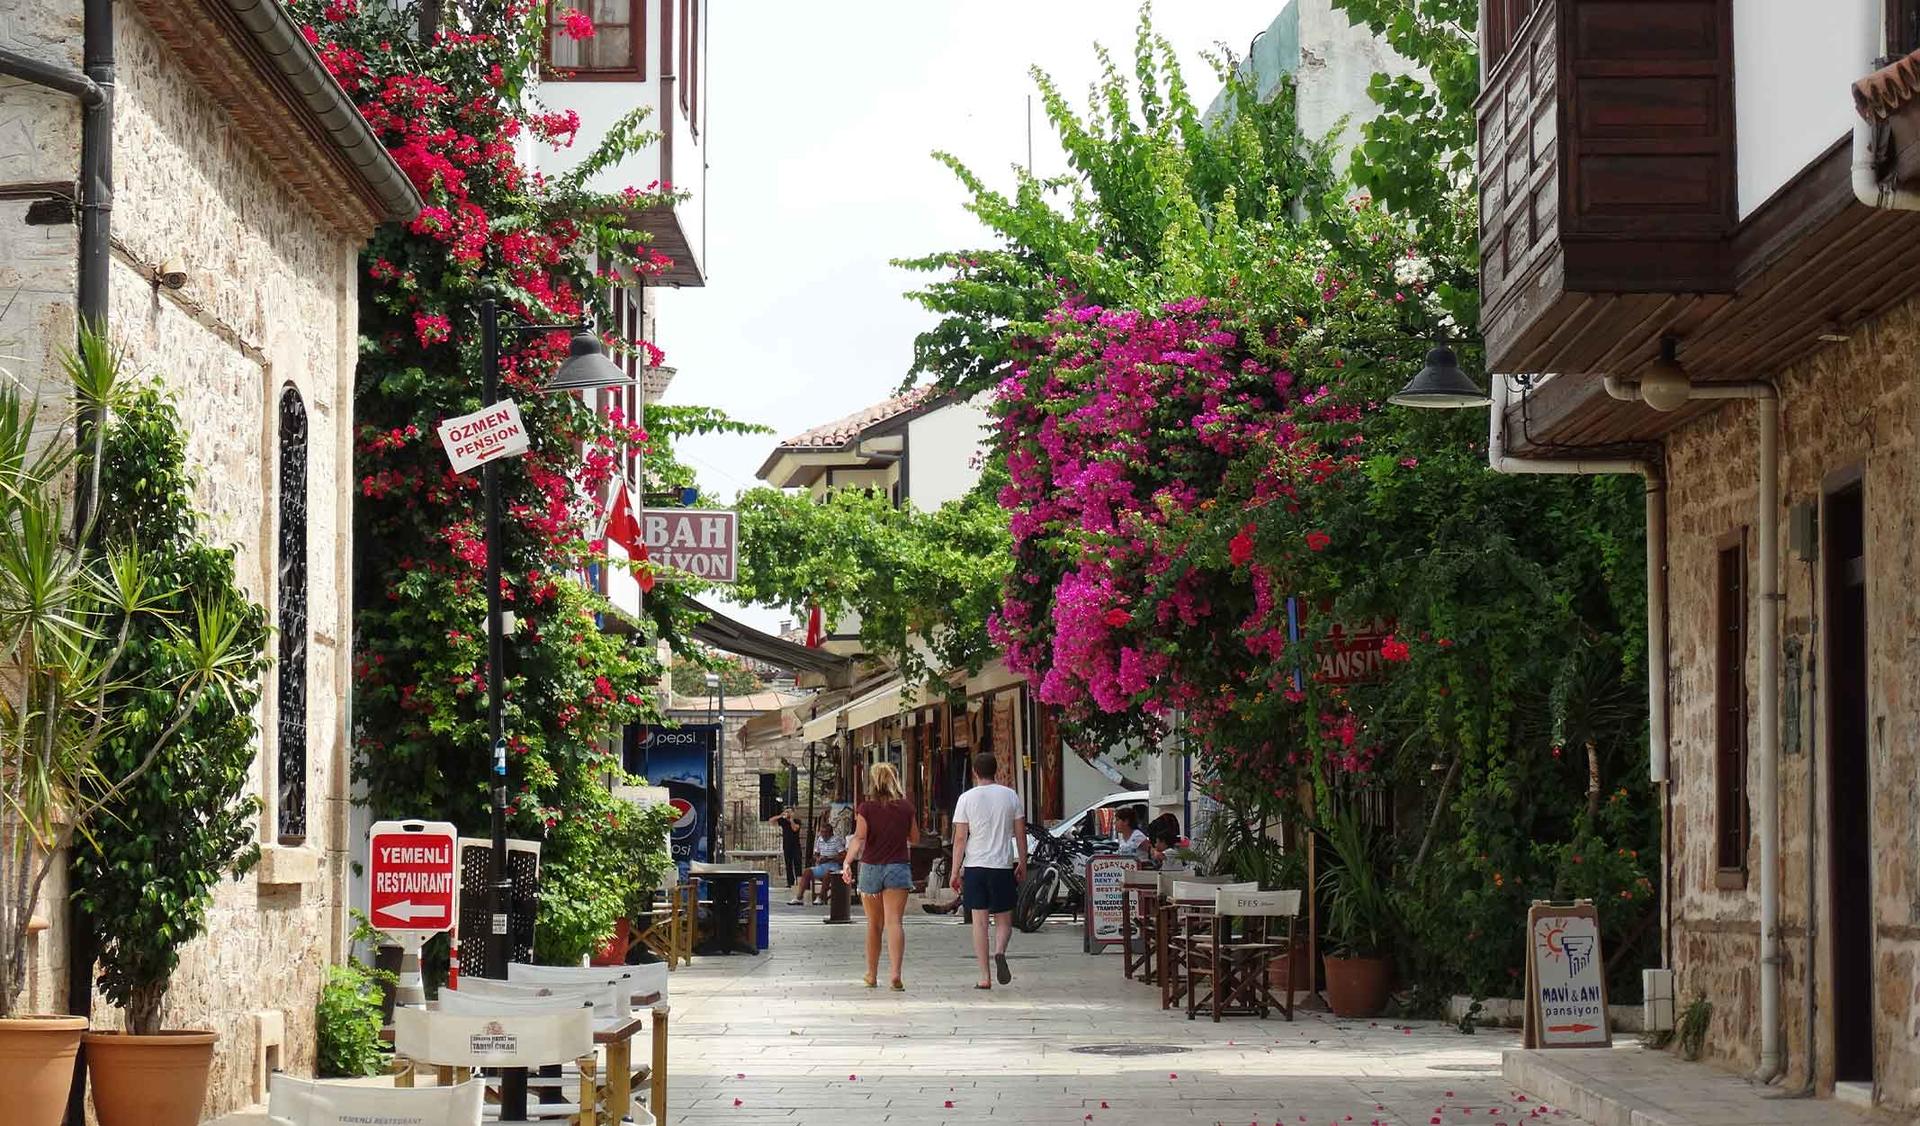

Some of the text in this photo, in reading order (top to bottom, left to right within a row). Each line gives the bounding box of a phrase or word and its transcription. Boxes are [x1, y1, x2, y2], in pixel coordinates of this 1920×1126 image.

[448, 410, 510, 442] ÖZMEN
[456, 424, 519, 458] PENSION
[645, 516, 727, 548] BAH
[648, 547, 728, 577] SİYON
[656, 732, 696, 746] pepsi
[380, 844, 449, 864] YEMENLİ
[376, 872, 452, 893] RESTAURANT
[1237, 899, 1259, 908] EFES
[1542, 982, 1600, 1002] MAVİ & ANI
[1546, 1005, 1599, 1018] pansiyon
